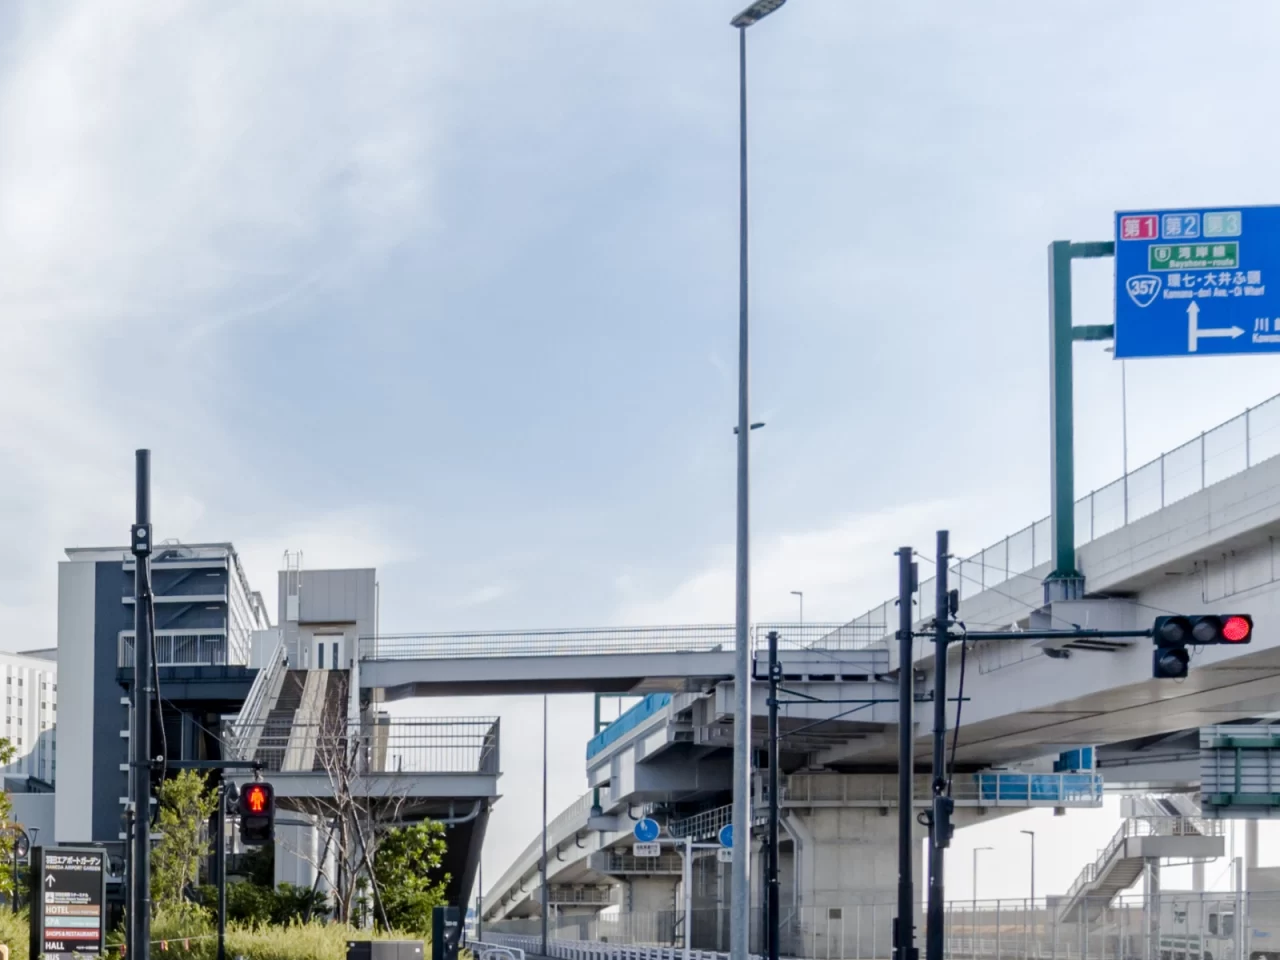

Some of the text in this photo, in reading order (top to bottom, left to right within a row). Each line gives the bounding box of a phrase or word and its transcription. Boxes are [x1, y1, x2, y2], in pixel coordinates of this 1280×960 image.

[1130, 280, 1157, 296] 357
[45, 905, 69, 914] HOTEL
[45, 918, 60, 926] SPA
[45, 941, 65, 950] HALL
